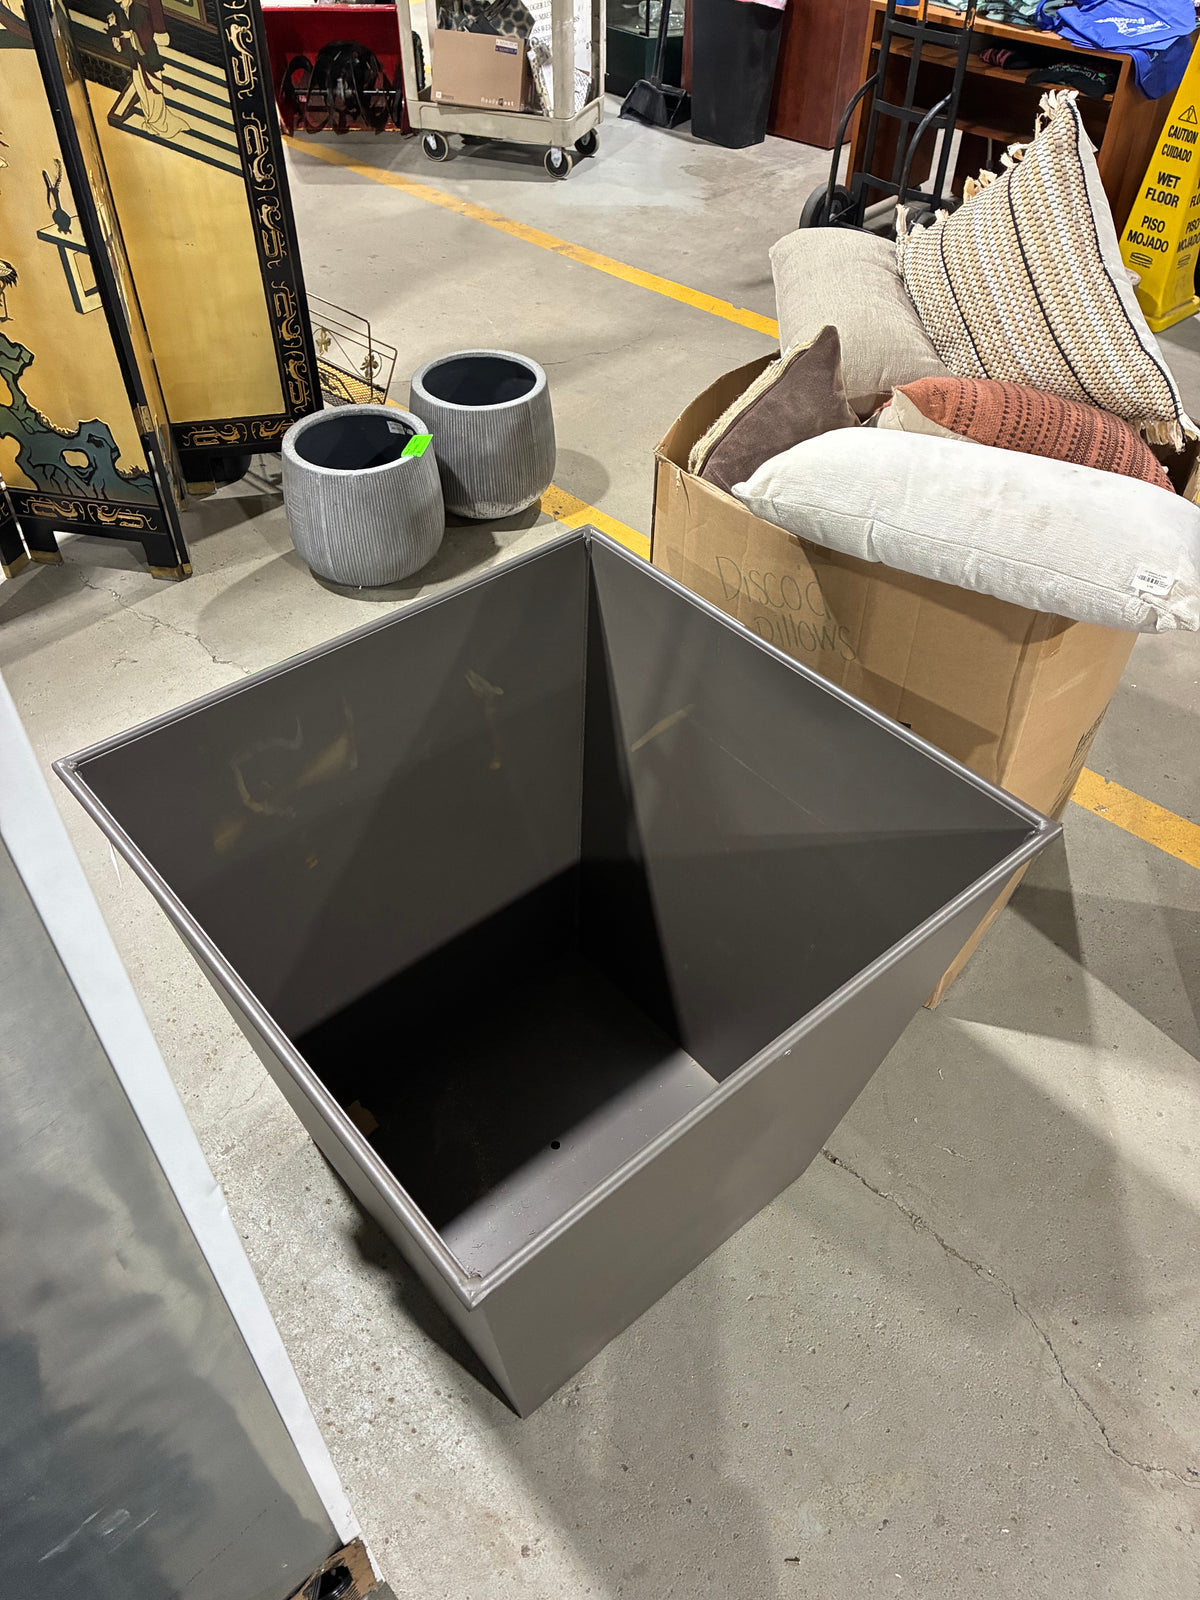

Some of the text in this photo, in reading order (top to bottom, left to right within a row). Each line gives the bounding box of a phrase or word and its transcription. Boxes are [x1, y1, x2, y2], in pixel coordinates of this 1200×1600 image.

[1168, 125, 1199, 145] CAUTION
[1161, 144, 1193, 163] CUIDADO
[1157, 171, 1181, 189] WET
[1145, 187, 1180, 209] FLOOR
[1141, 215, 1165, 233] PISO
[1126, 229, 1169, 253] MOJADO
